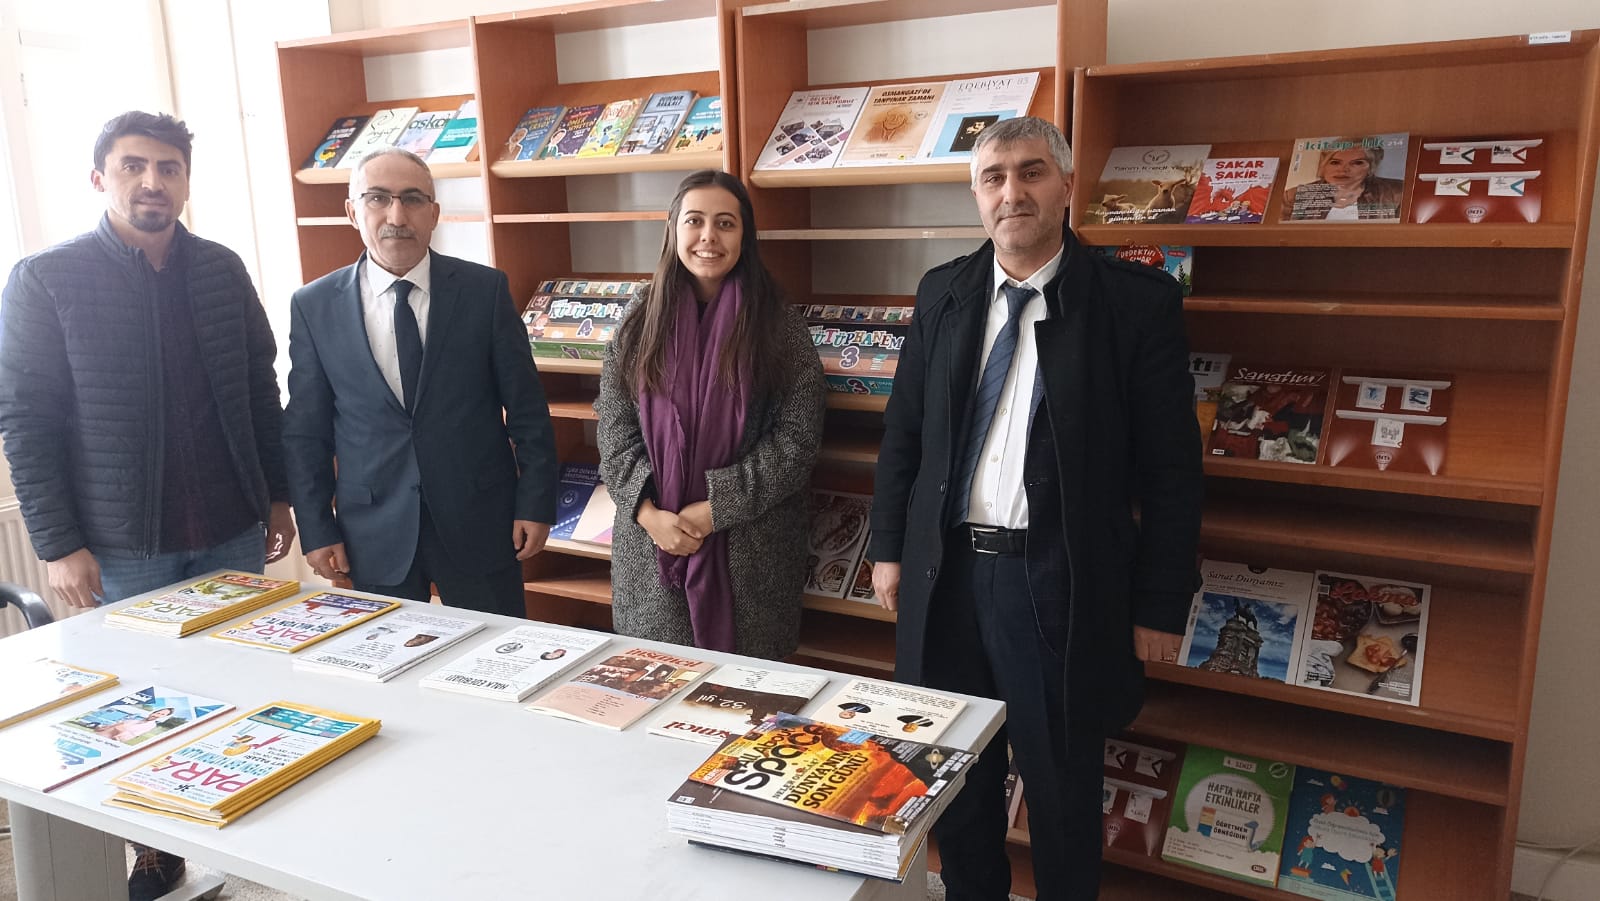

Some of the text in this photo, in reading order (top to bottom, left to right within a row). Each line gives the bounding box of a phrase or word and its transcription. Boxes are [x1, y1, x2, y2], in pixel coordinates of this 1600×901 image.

[1215, 170, 1258, 180] ŞAKİR
[1216, 160, 1264, 169] SAKAR
[840, 346, 860, 369] 3
[485, 681, 509, 690] HALK
[724, 723, 824, 791] Space
[739, 728, 796, 769] All About
[784, 751, 852, 804] DÜNYA'NIN
[772, 779, 794, 800] NELER
[803, 785, 833, 809] SON
[1207, 782, 1262, 803] HAFTA HAFTA
[1205, 793, 1261, 815] ETKİNLİKLER
[1215, 819, 1248, 834] ÖĞRETMEN
